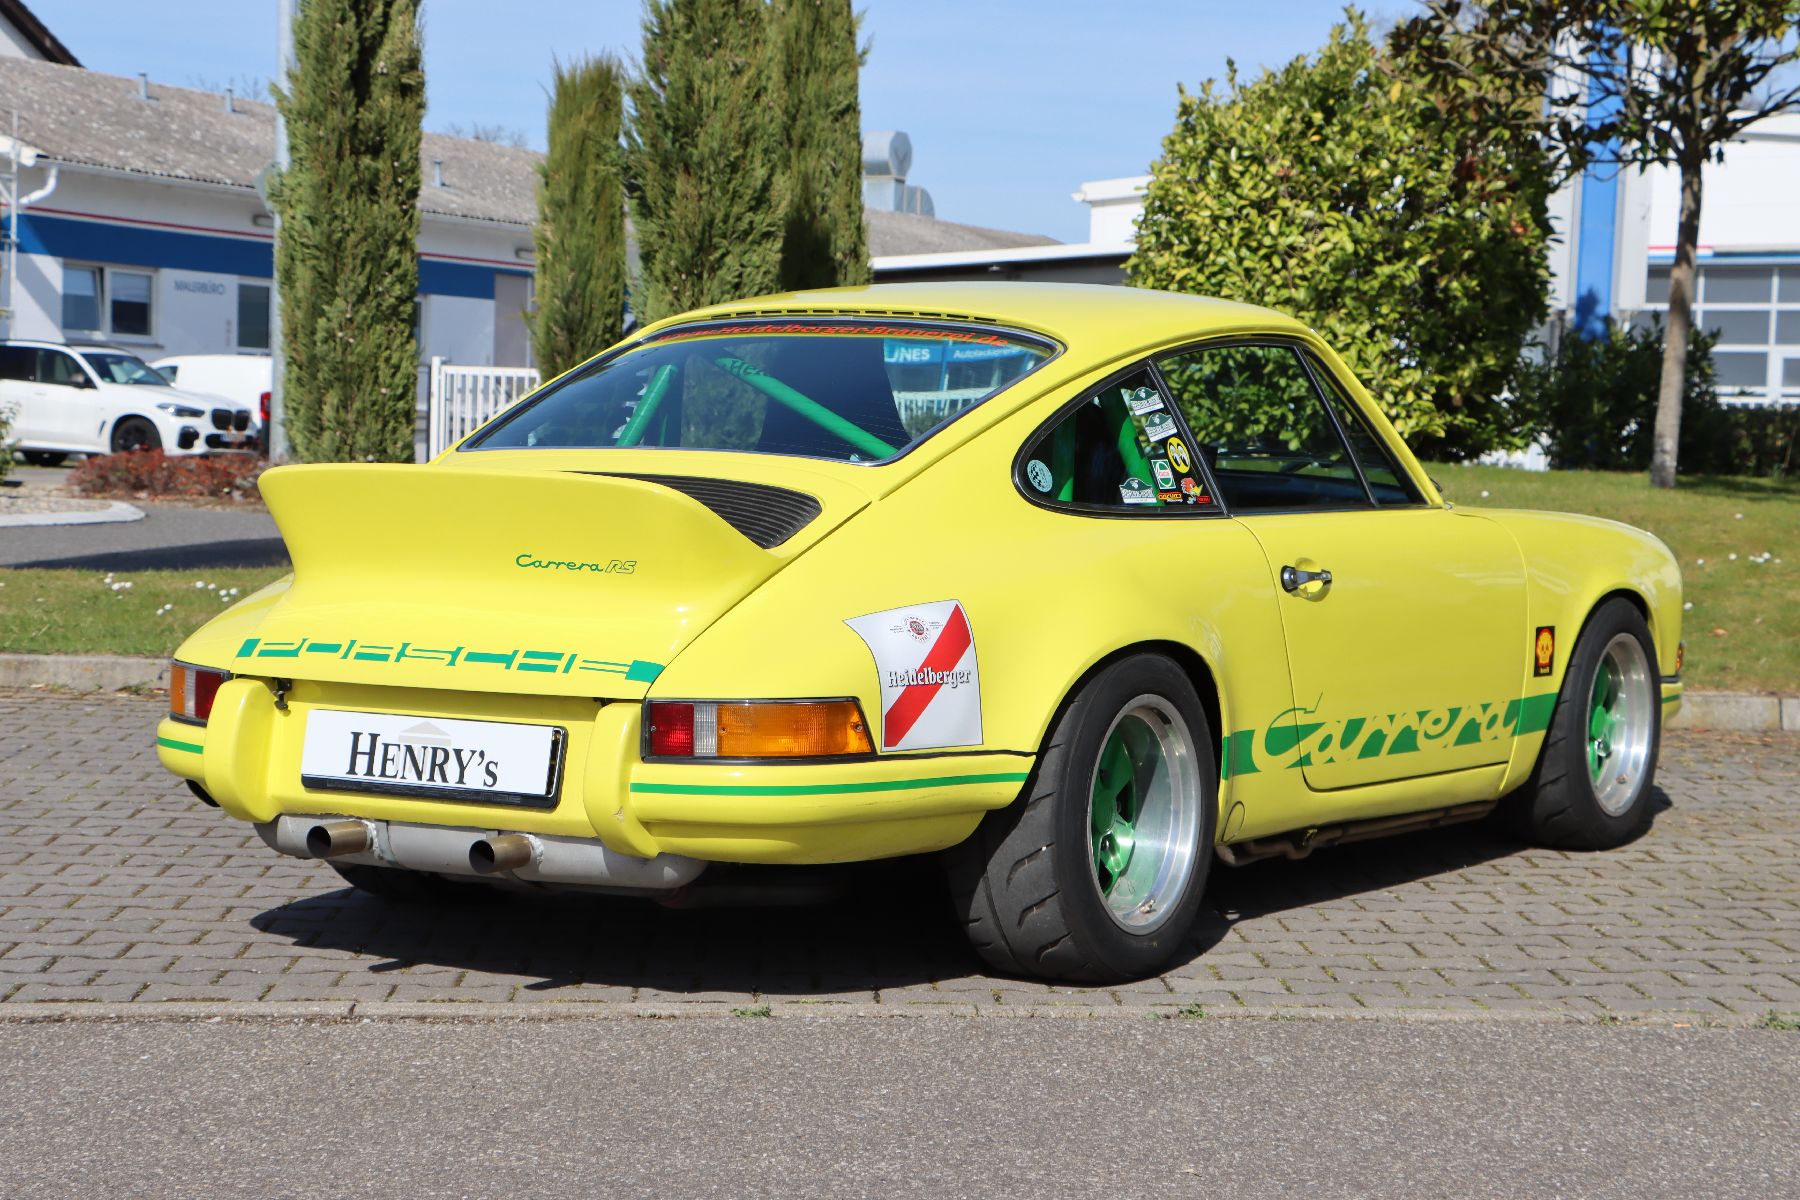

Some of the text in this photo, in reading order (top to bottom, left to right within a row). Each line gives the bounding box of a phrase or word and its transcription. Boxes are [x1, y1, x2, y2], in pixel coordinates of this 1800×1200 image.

[515, 553, 638, 575] Carrera RS
[252, 637, 632, 678] PORSCHE
[888, 666, 971, 689] Heidelberger
[1251, 692, 1520, 773] Carrera
